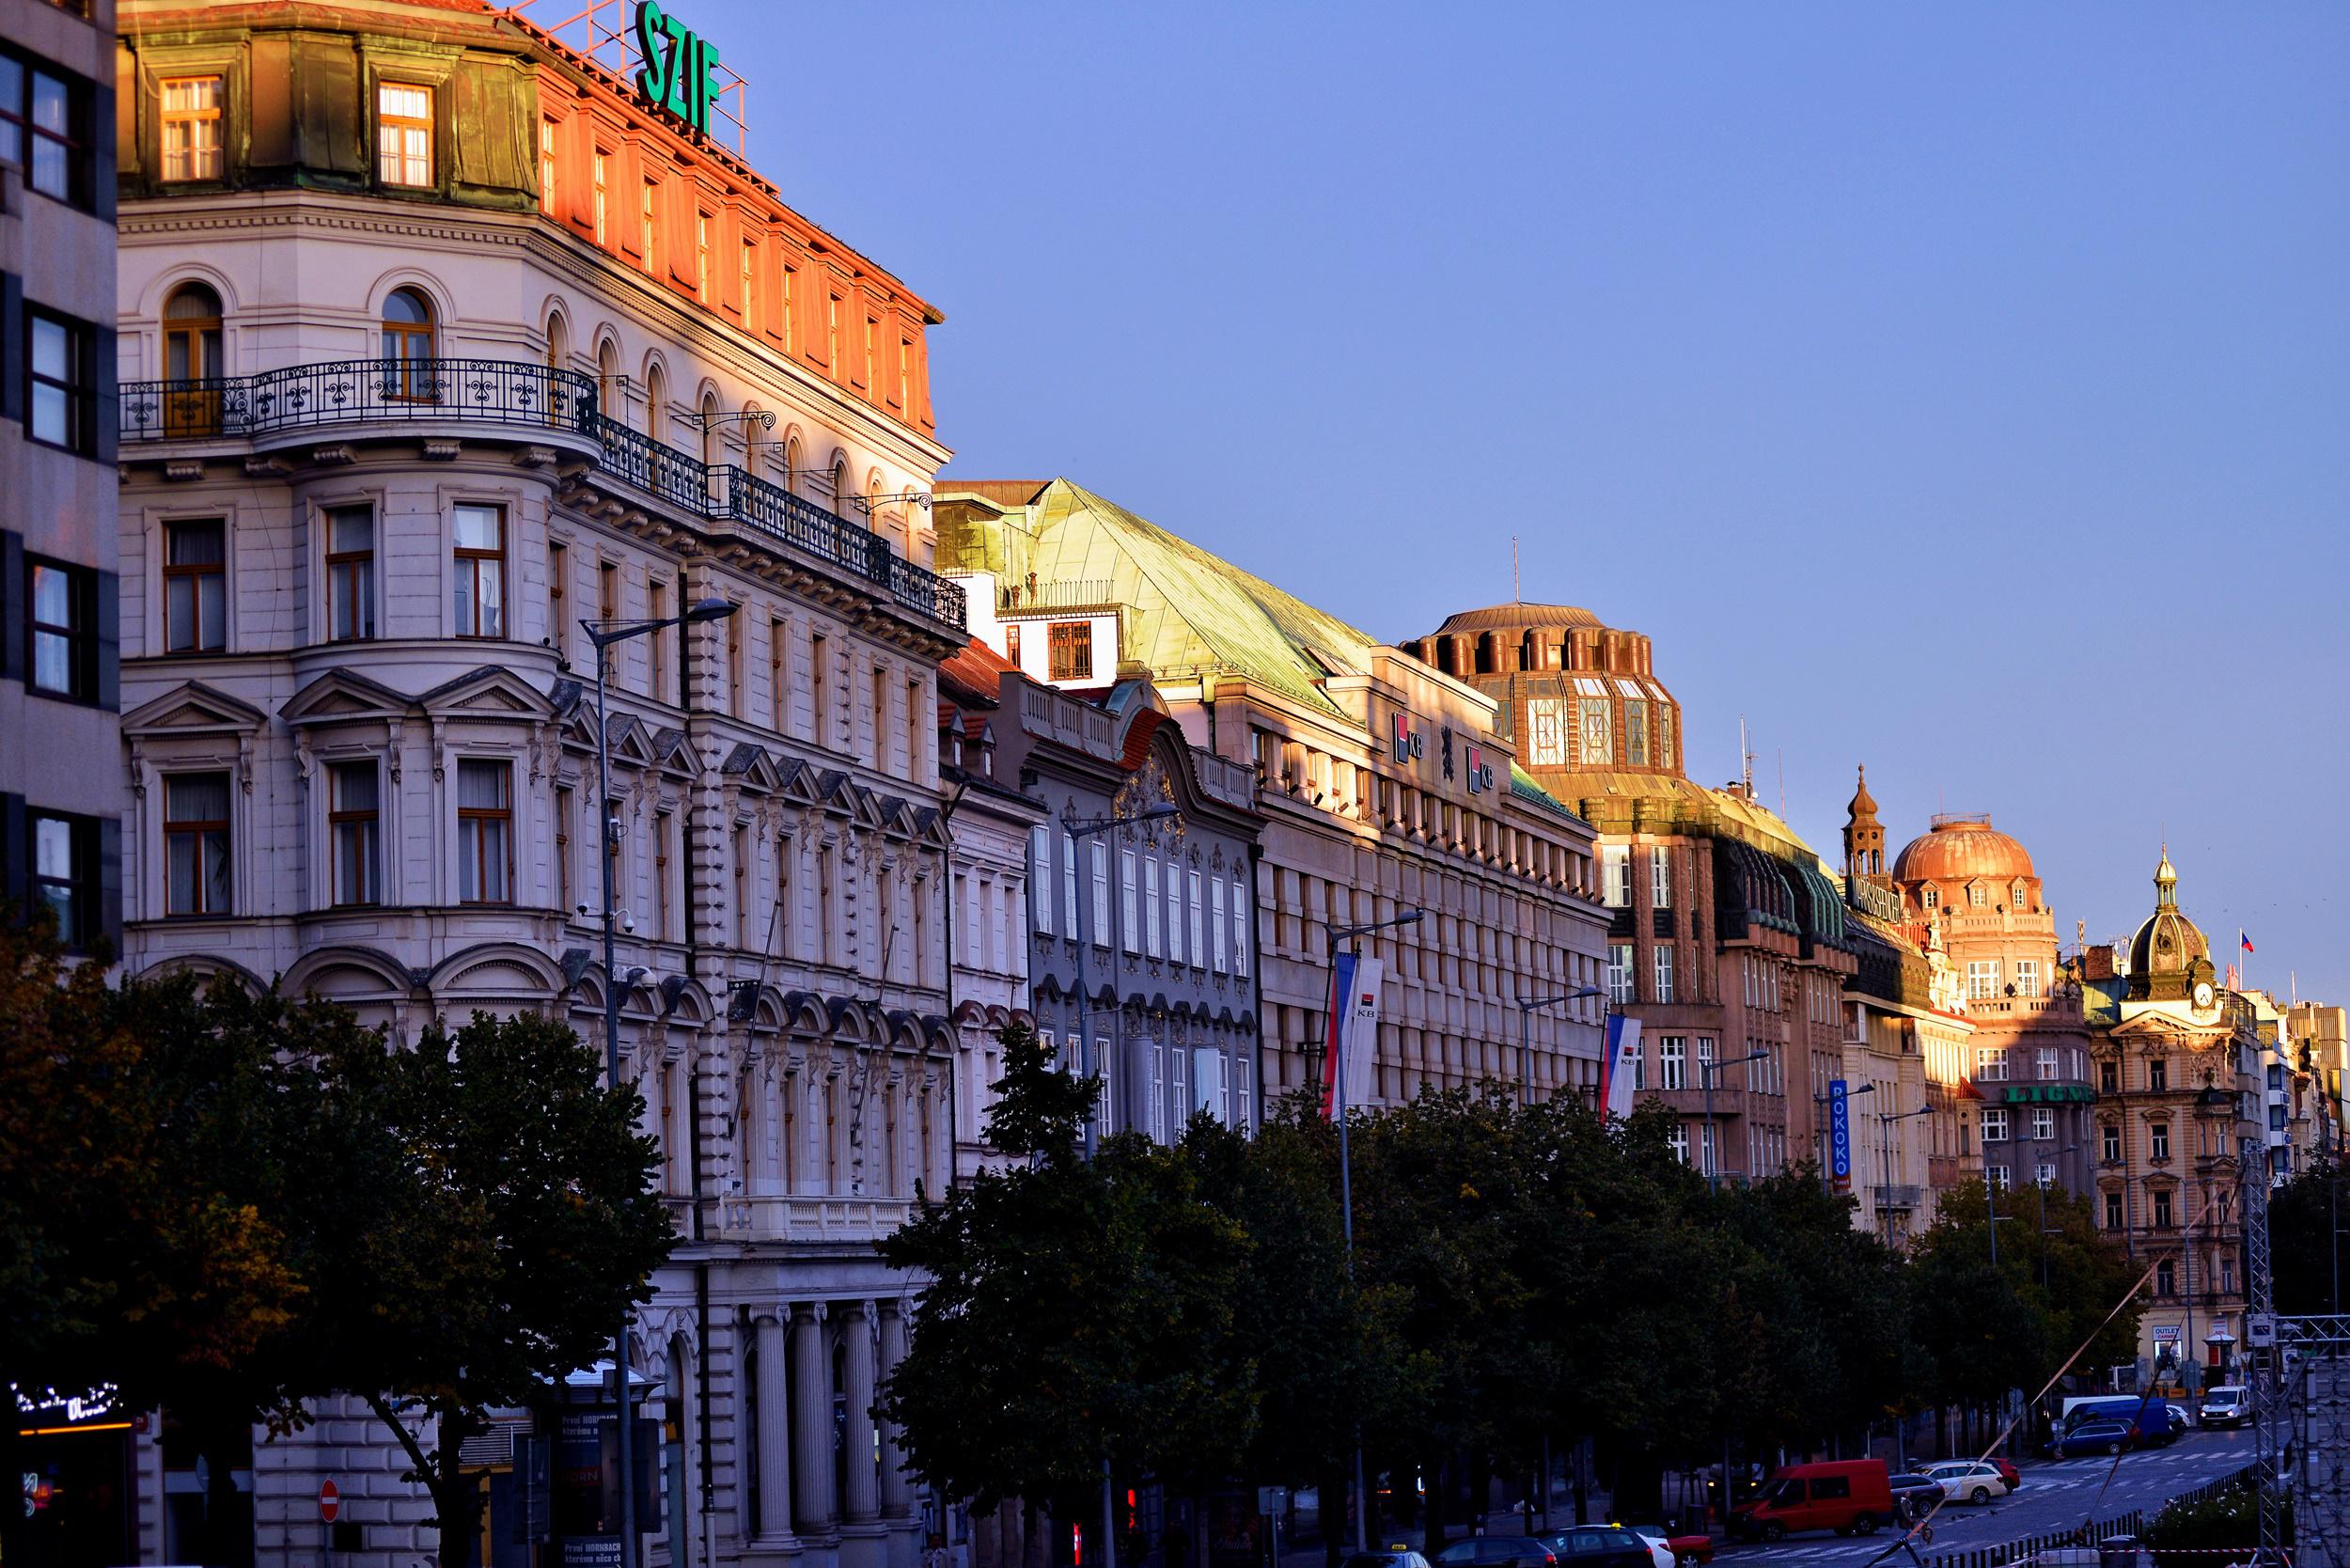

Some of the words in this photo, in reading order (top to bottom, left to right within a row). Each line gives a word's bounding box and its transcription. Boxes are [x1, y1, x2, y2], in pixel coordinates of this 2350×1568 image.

[637, 1, 719, 135] SZIF
[1409, 732, 1423, 759] KB
[1480, 763, 1494, 790] KB
[1833, 1087, 1847, 1174] ROKOKO
[585, 1542, 620, 1552] HORNBACH
